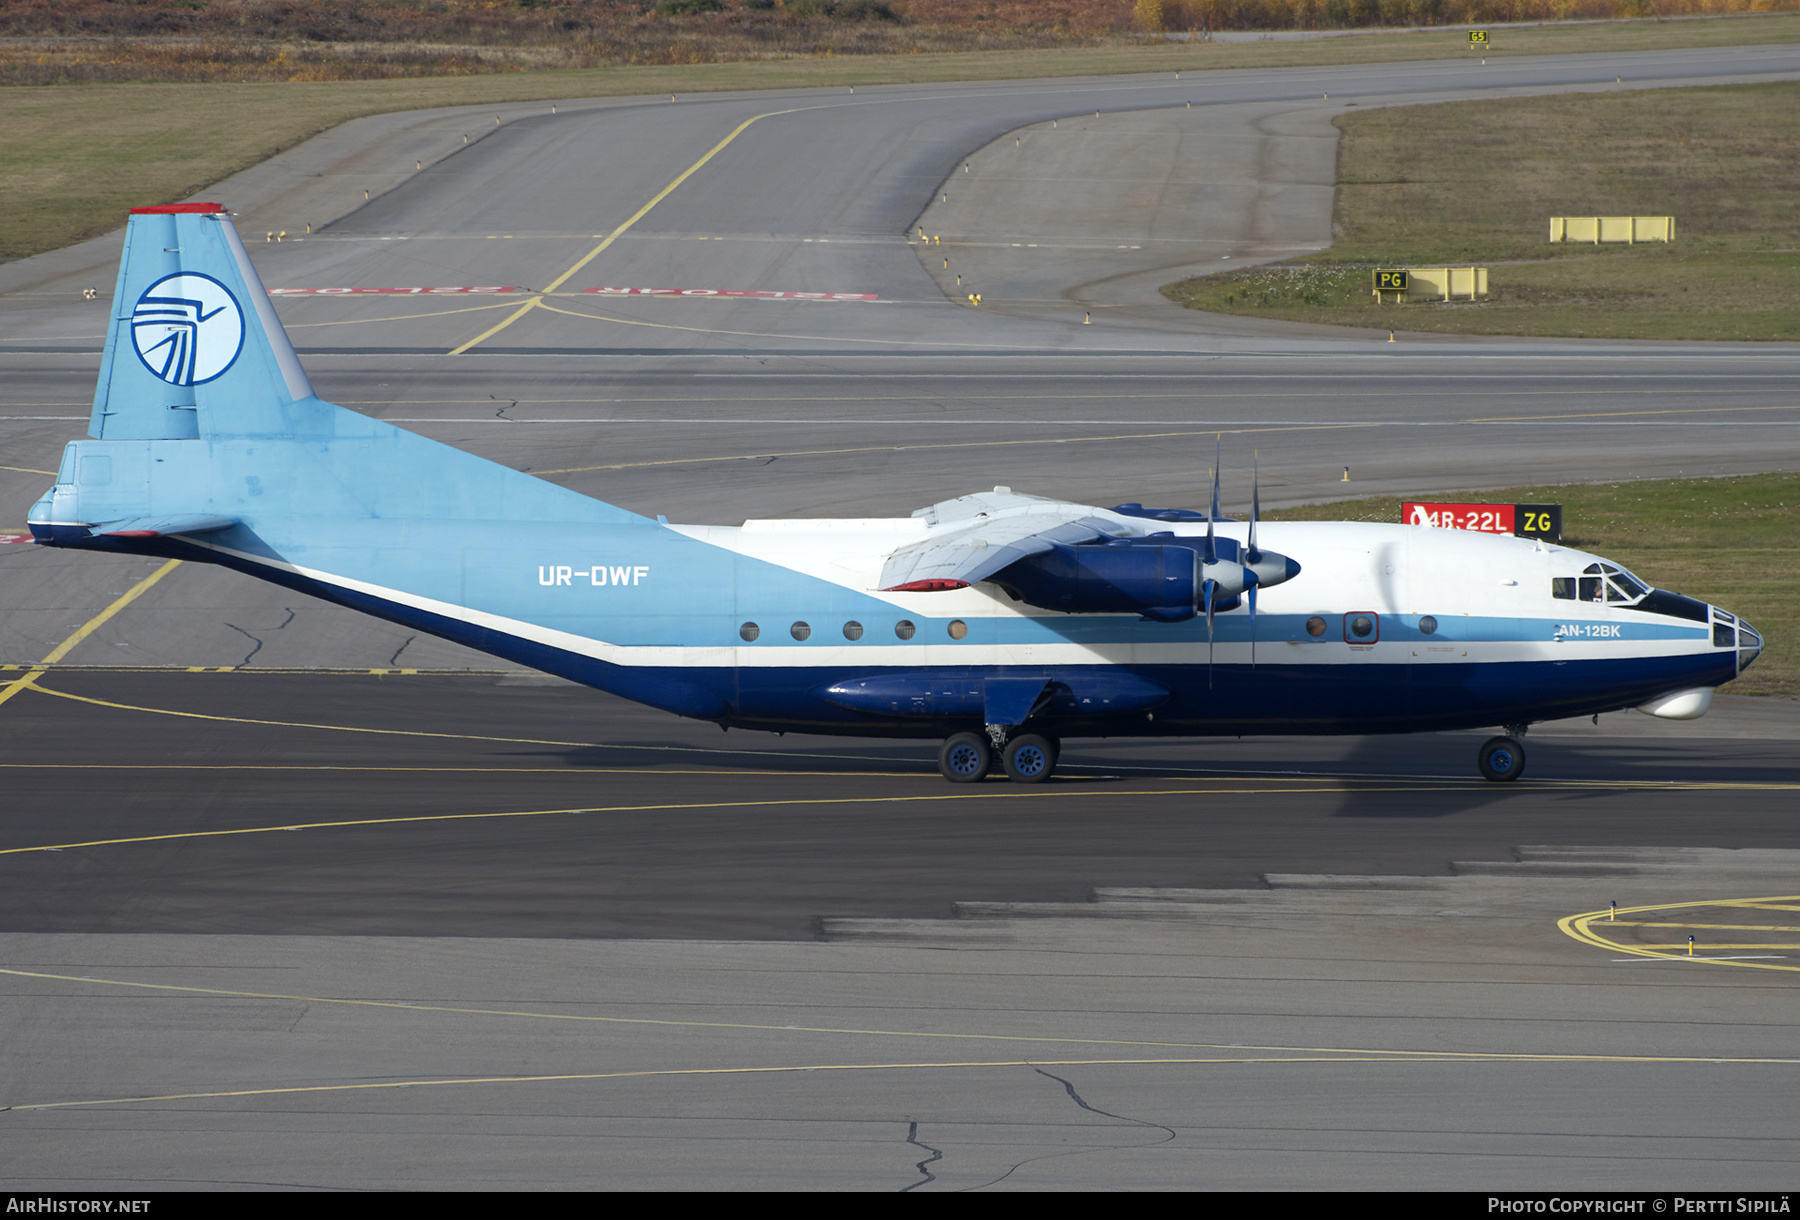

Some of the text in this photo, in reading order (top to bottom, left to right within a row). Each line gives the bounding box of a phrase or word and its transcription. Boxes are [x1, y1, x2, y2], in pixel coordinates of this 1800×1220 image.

[1471, 32, 1484, 41] G5
[1381, 273, 1401, 287] PG
[1523, 512, 1551, 532] ZG
[538, 565, 649, 586] UR-DWF
[1559, 624, 1621, 637] AN-12BK
